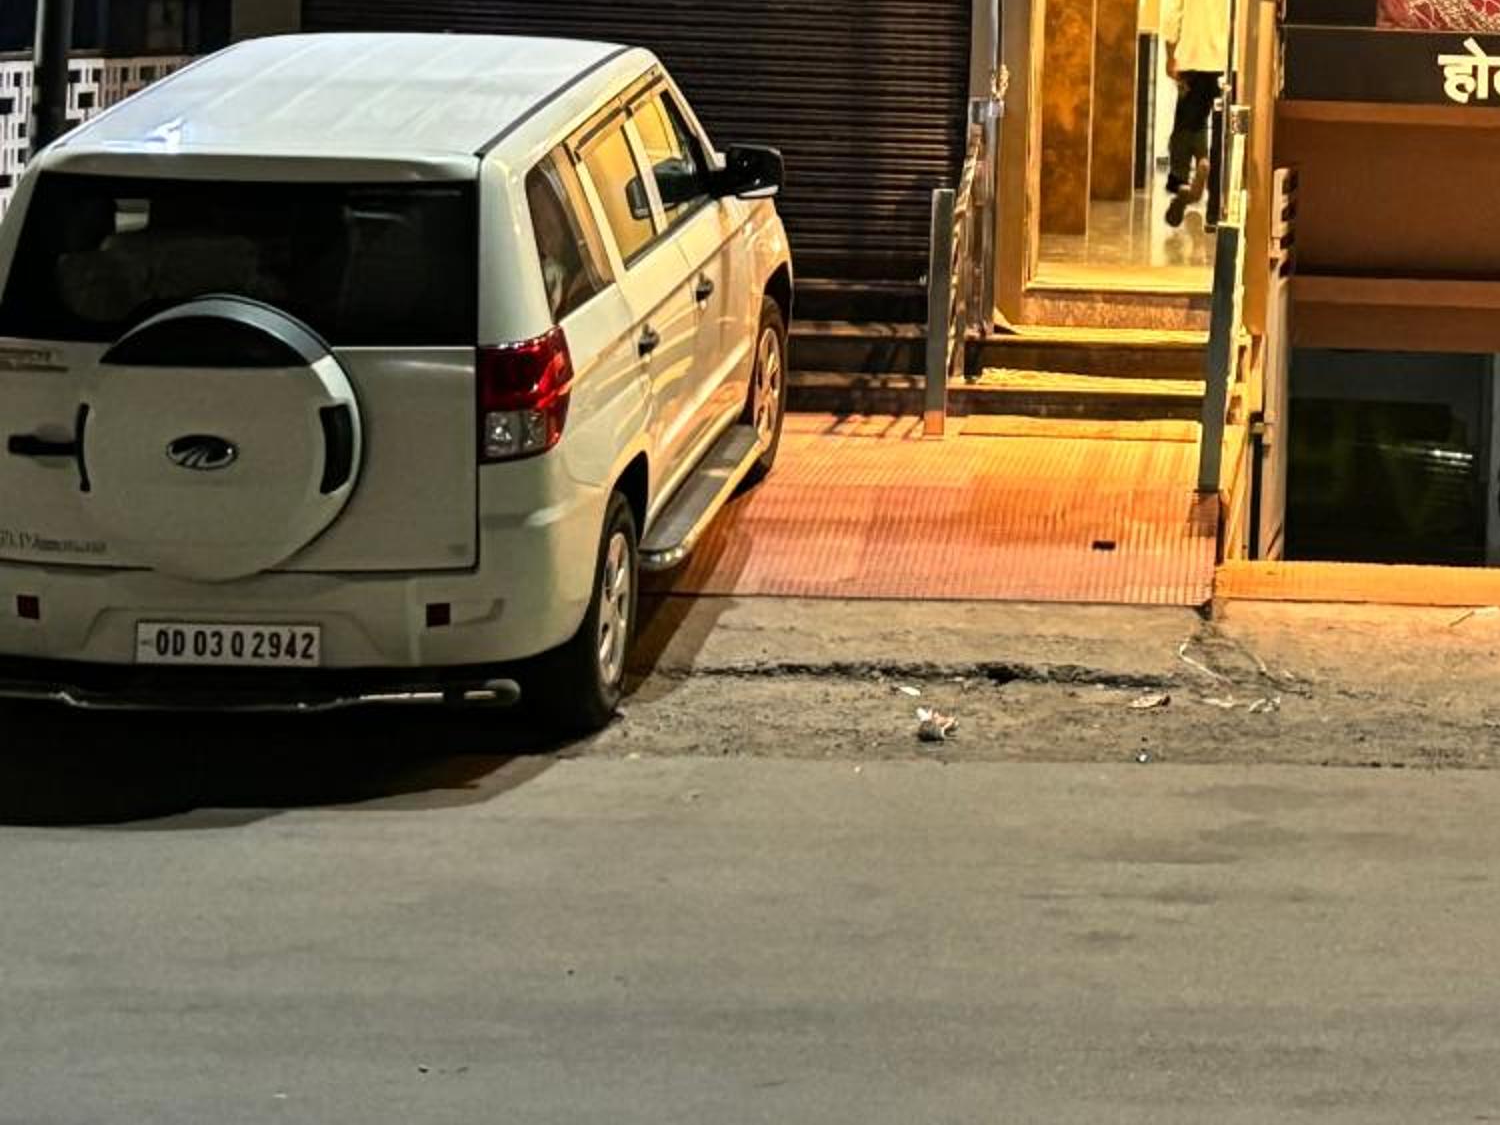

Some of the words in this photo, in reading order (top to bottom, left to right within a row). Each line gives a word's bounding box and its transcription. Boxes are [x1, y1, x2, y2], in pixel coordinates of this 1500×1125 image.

[156, 629, 186, 656] OD
[194, 630, 223, 657] 03
[252, 632, 315, 659] 2942
